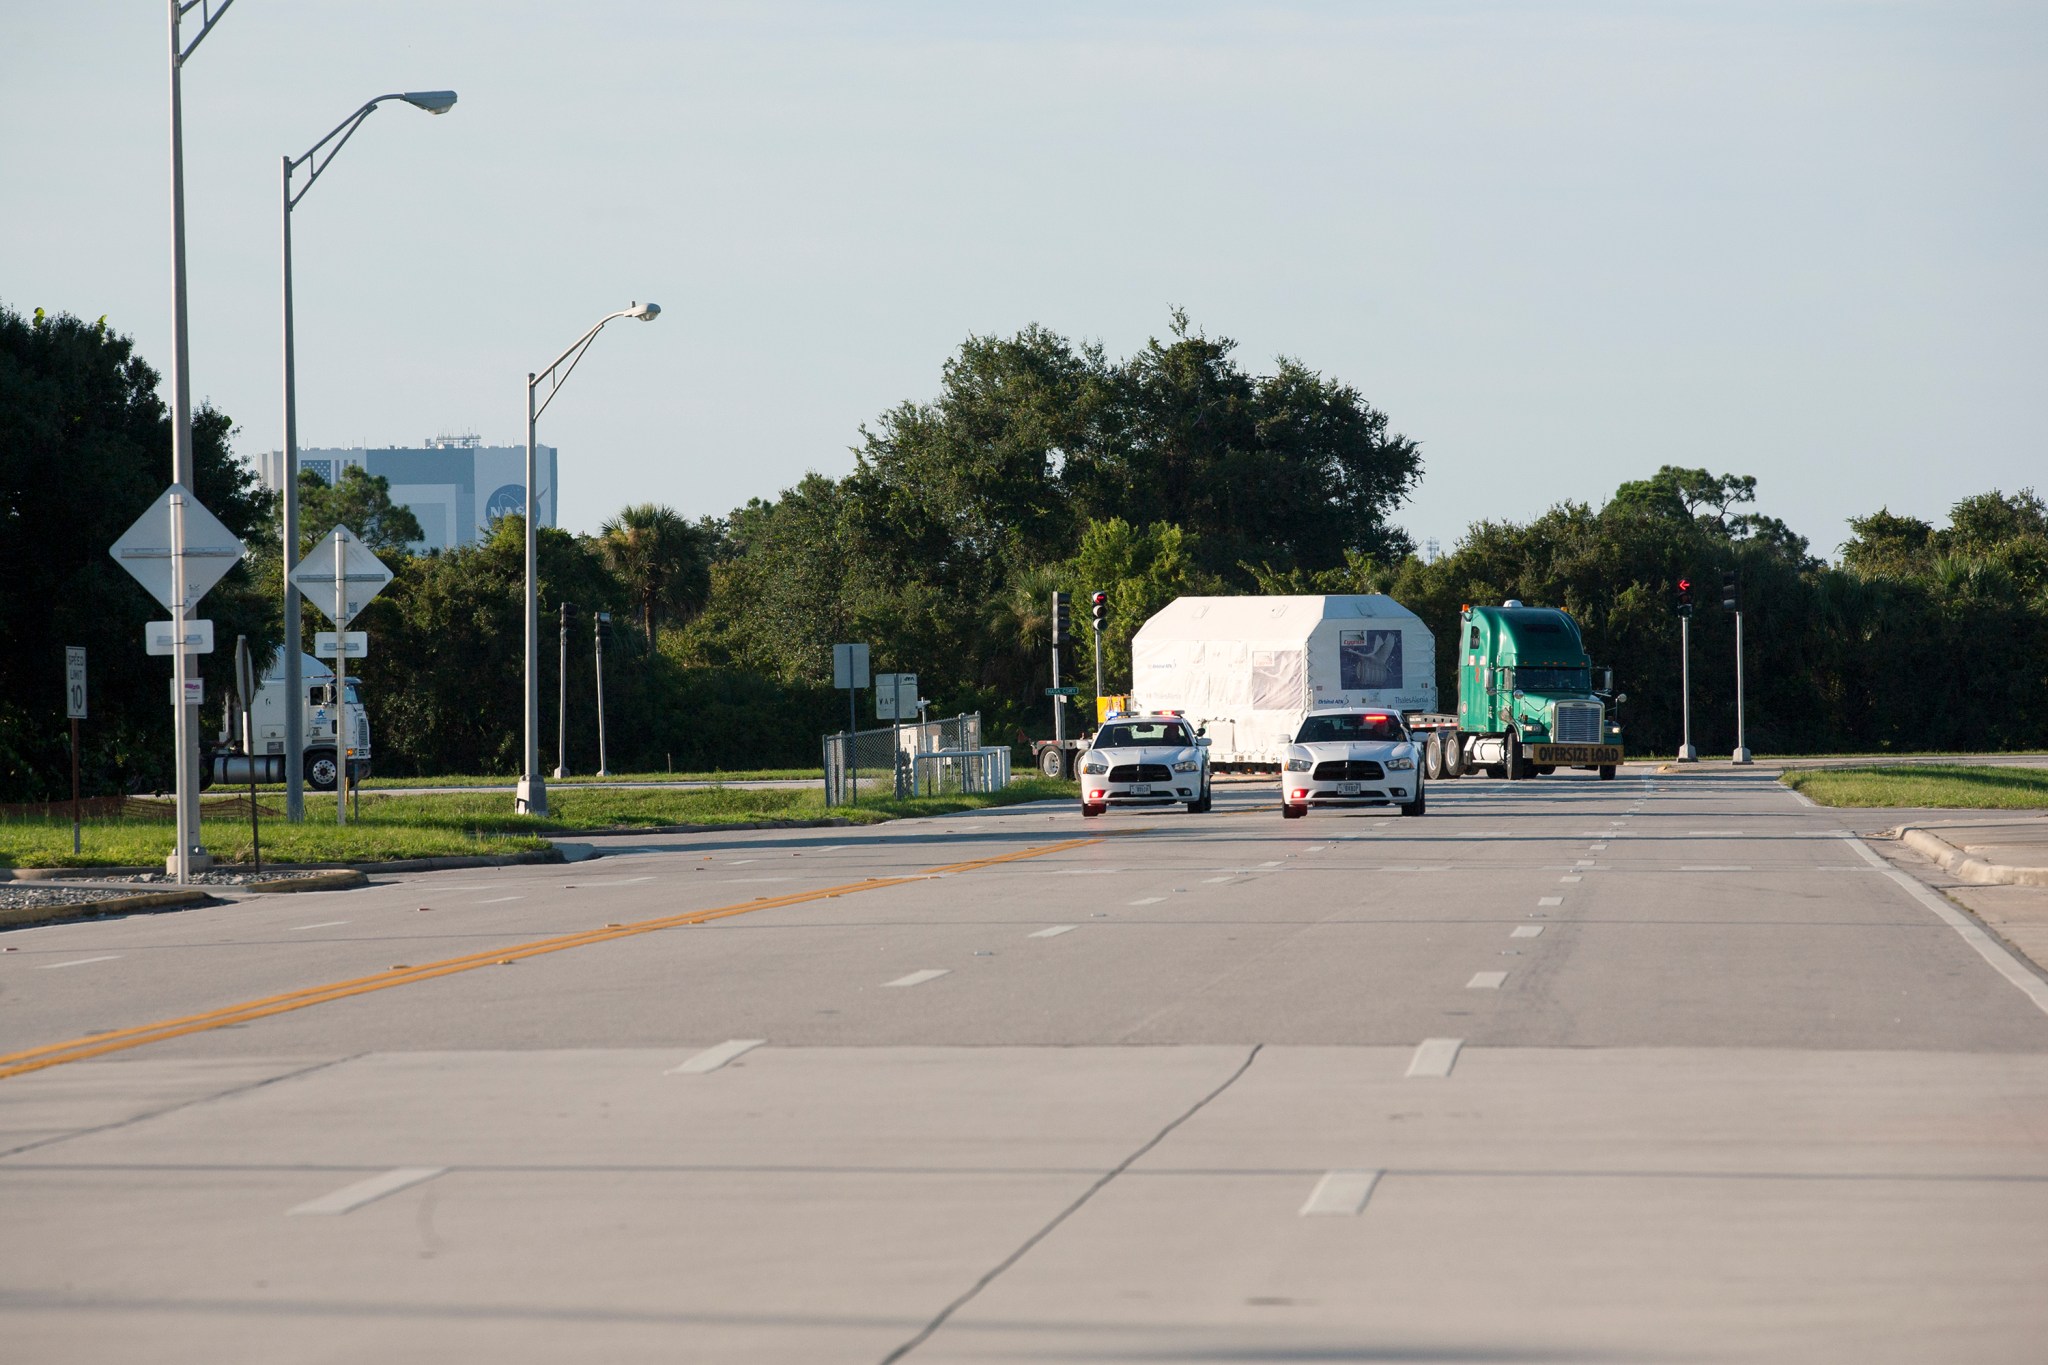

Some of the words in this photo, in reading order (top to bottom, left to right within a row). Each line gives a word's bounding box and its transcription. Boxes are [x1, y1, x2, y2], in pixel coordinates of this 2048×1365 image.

[491, 506, 537, 517] NAS
[68, 655, 84, 667] SPEED
[70, 669, 83, 680] LIMIT
[71, 684, 83, 709] 10
[1539, 746, 1588, 762] OVERSIZE
[1591, 746, 1619, 761] LOAD
